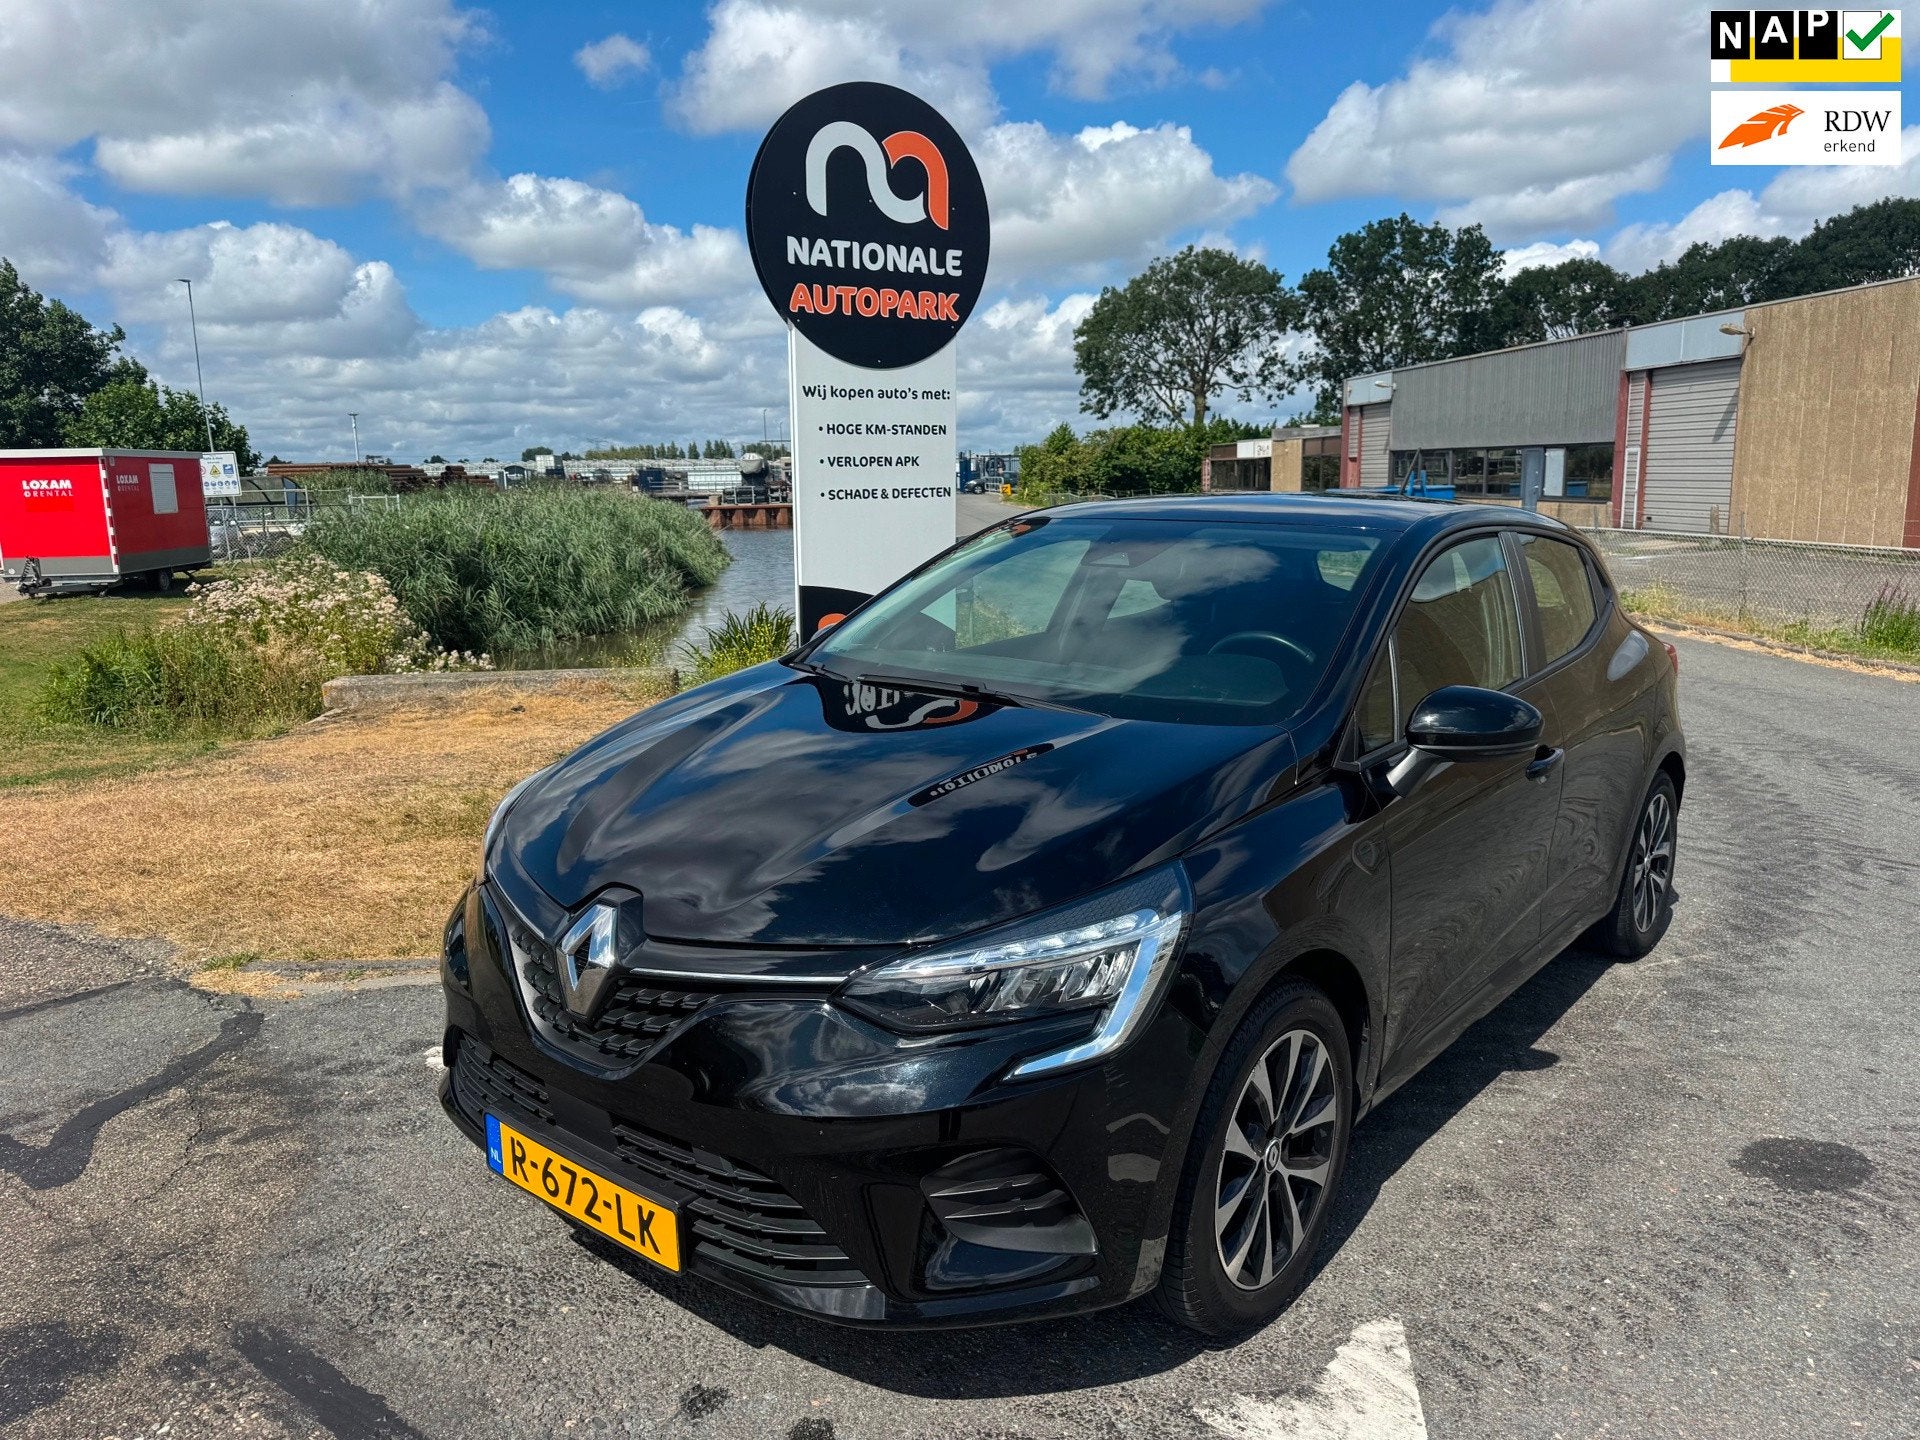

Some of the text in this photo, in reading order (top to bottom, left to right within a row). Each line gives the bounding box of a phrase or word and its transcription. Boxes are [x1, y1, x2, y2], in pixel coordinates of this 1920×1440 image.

[787, 235, 963, 277] NATIONALE
[789, 282, 960, 321] AUTOPARK
[802, 385, 951, 401] Wij kopen auto's met:
[826, 423, 947, 435] HOGE KM-STANDEN
[827, 456, 920, 467] VERLOPEN APK
[22, 479, 73, 490] LOXAM
[116, 474, 139, 484] LOXAM
[828, 486, 951, 500] SCHADE & DEFECTEN
[490, 1147, 501, 1164] NL
[510, 1136, 661, 1255] R-672-LK
